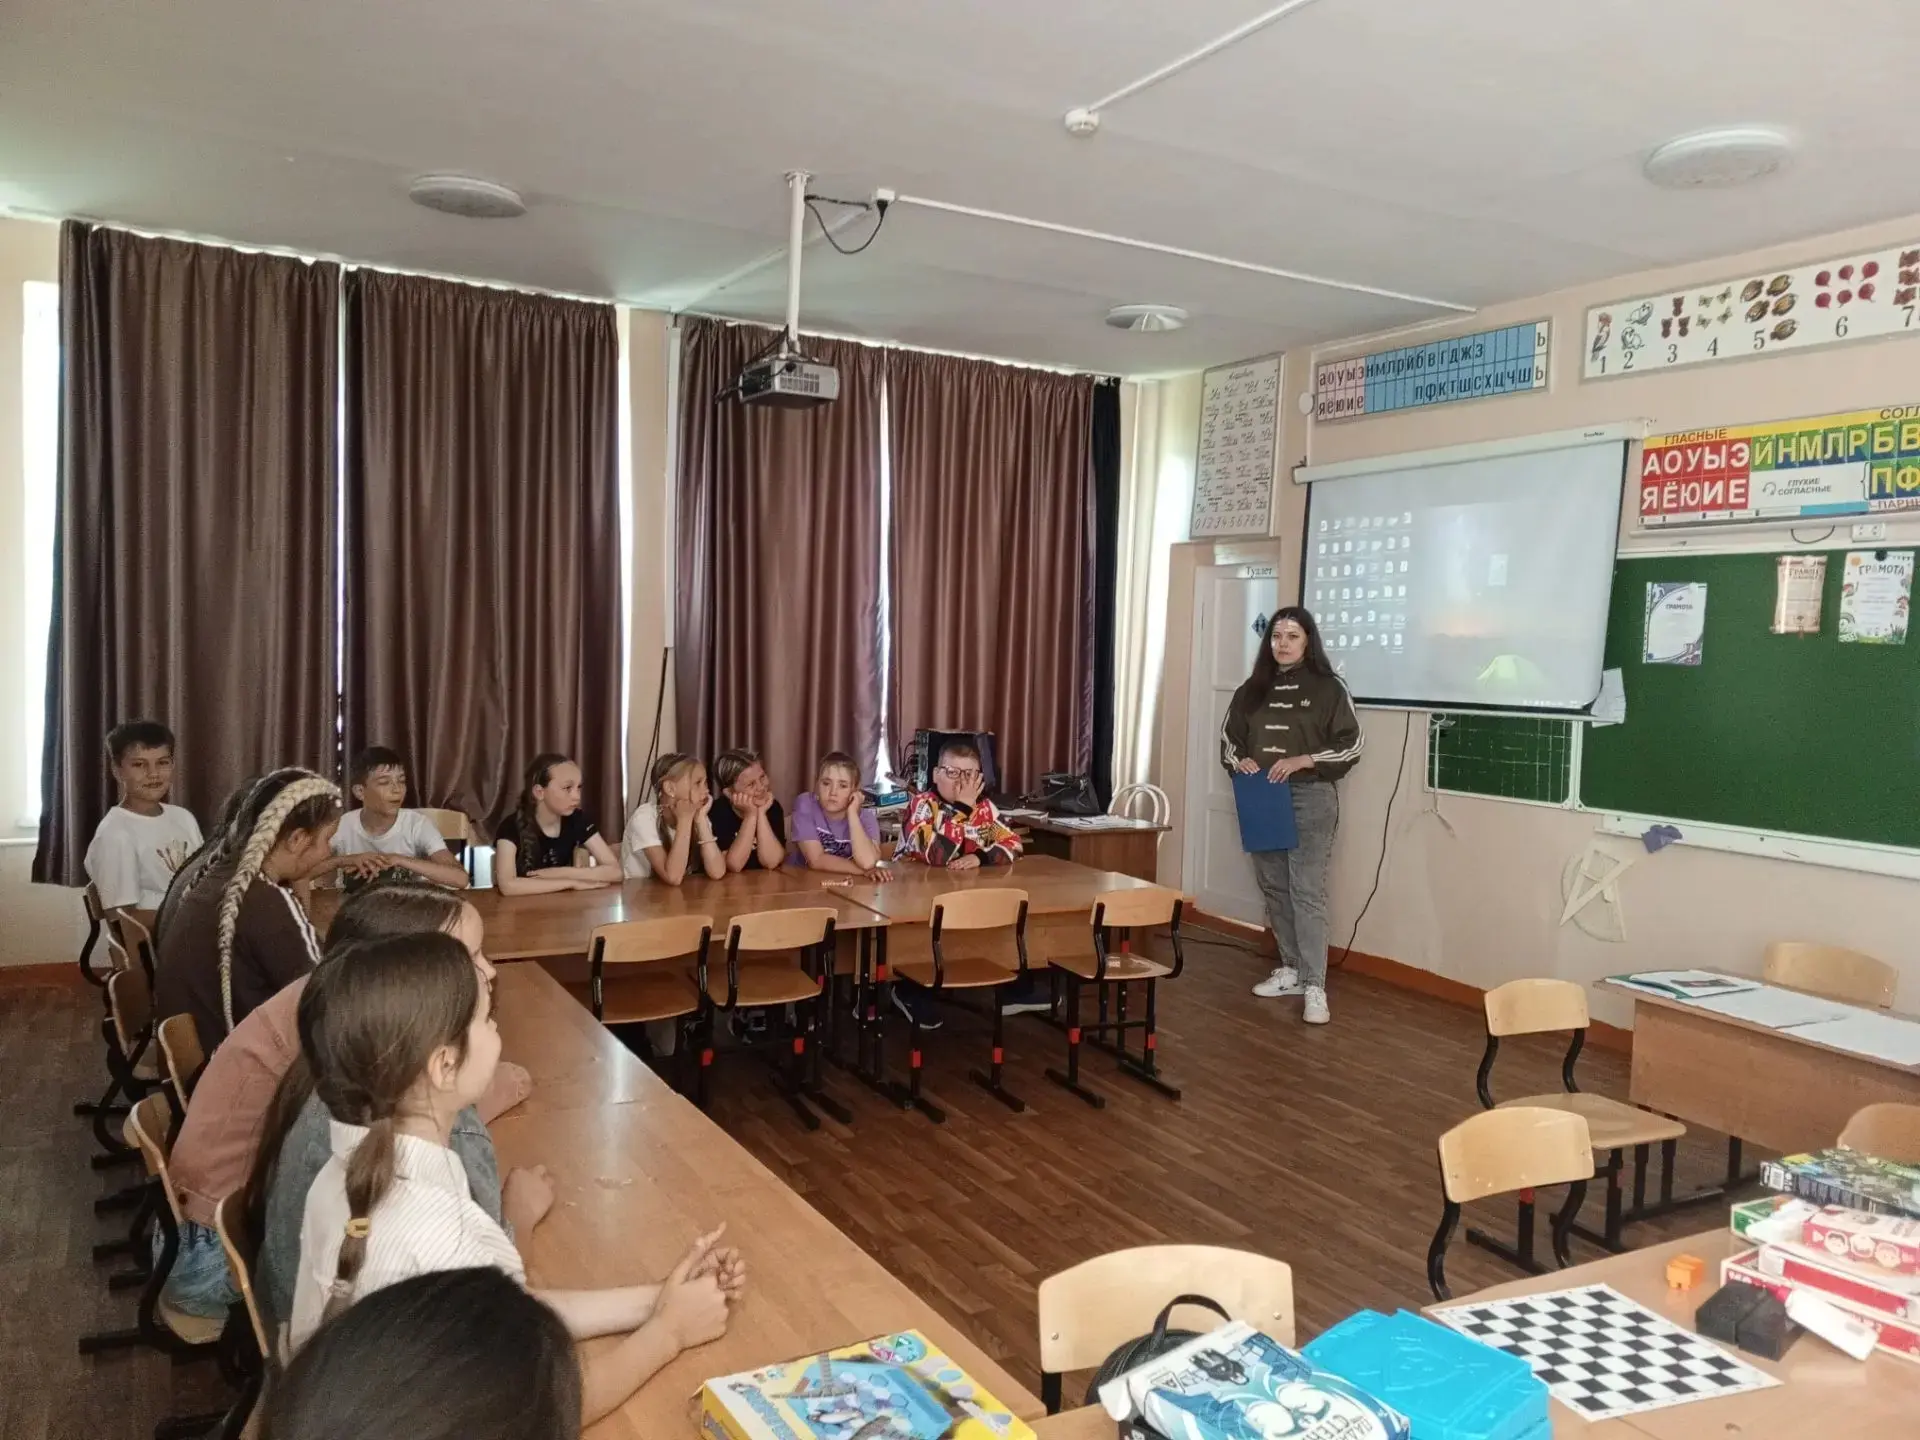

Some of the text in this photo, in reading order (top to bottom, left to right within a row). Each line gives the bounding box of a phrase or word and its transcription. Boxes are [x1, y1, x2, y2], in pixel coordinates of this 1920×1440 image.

[1600, 305, 1915, 374] 1 2 3 4 5 6 7
[1664, 428, 1728, 446] ГЛАСНЫЕ
[1787, 477, 1820, 488] ГЛУХИЕ
[1777, 485, 1832, 496] СОГЛАСНЫЕ
